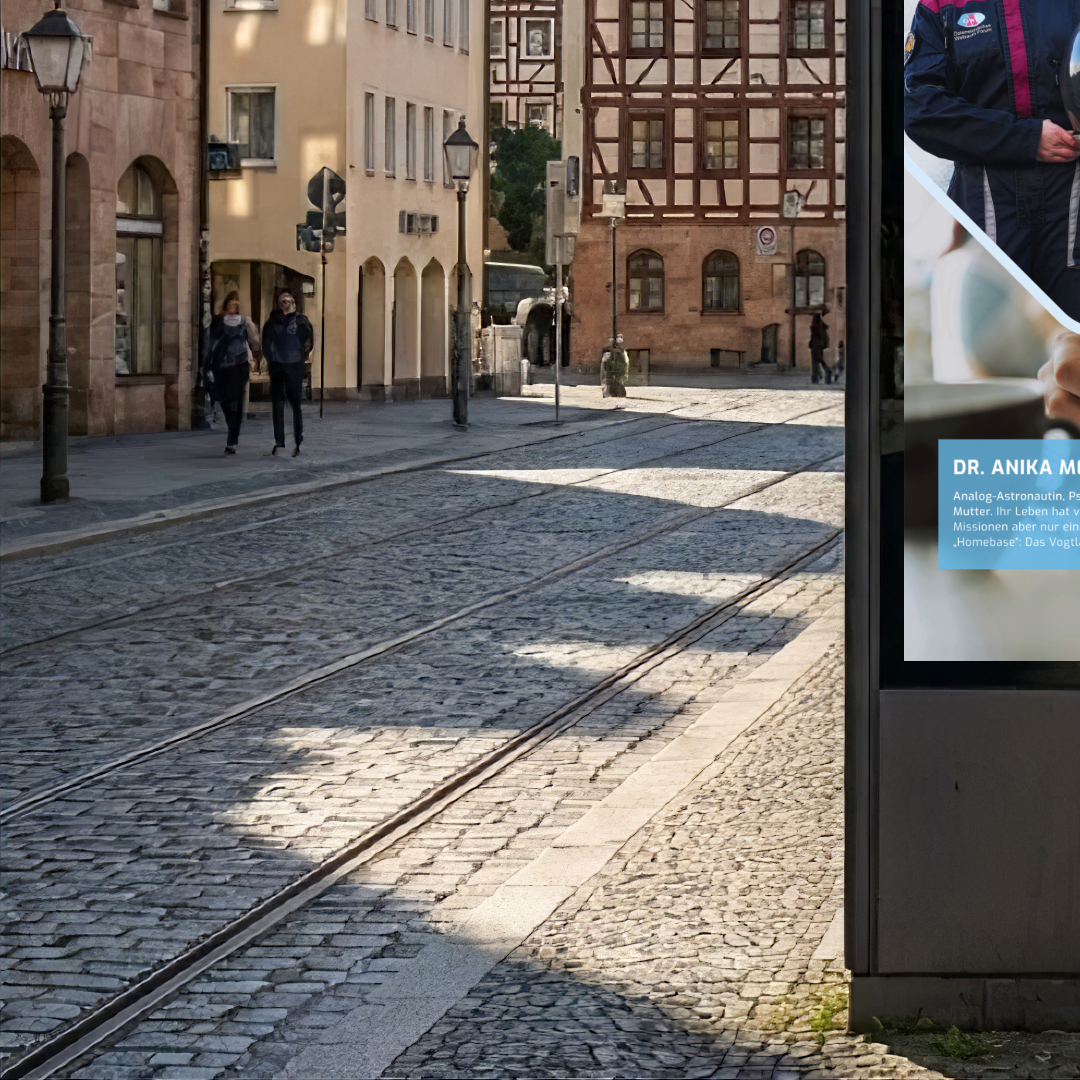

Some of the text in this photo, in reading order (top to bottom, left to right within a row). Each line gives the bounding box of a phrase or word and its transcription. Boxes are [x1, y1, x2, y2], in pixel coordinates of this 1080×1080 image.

[953, 459, 985, 476] DR.
[991, 459, 1053, 476] ANIKA
[953, 490, 1066, 504] Analog-Astronautin,
[953, 506, 993, 516] Mutter.
[996, 506, 1012, 516] Ihr
[1015, 506, 1049, 516] Leben
[1051, 506, 1070, 516] hat
[953, 521, 1009, 532] Missionen
[1011, 521, 1037, 532] aber
[1040, 523, 1060, 532] nur
[1025, 536, 1046, 547] Das
